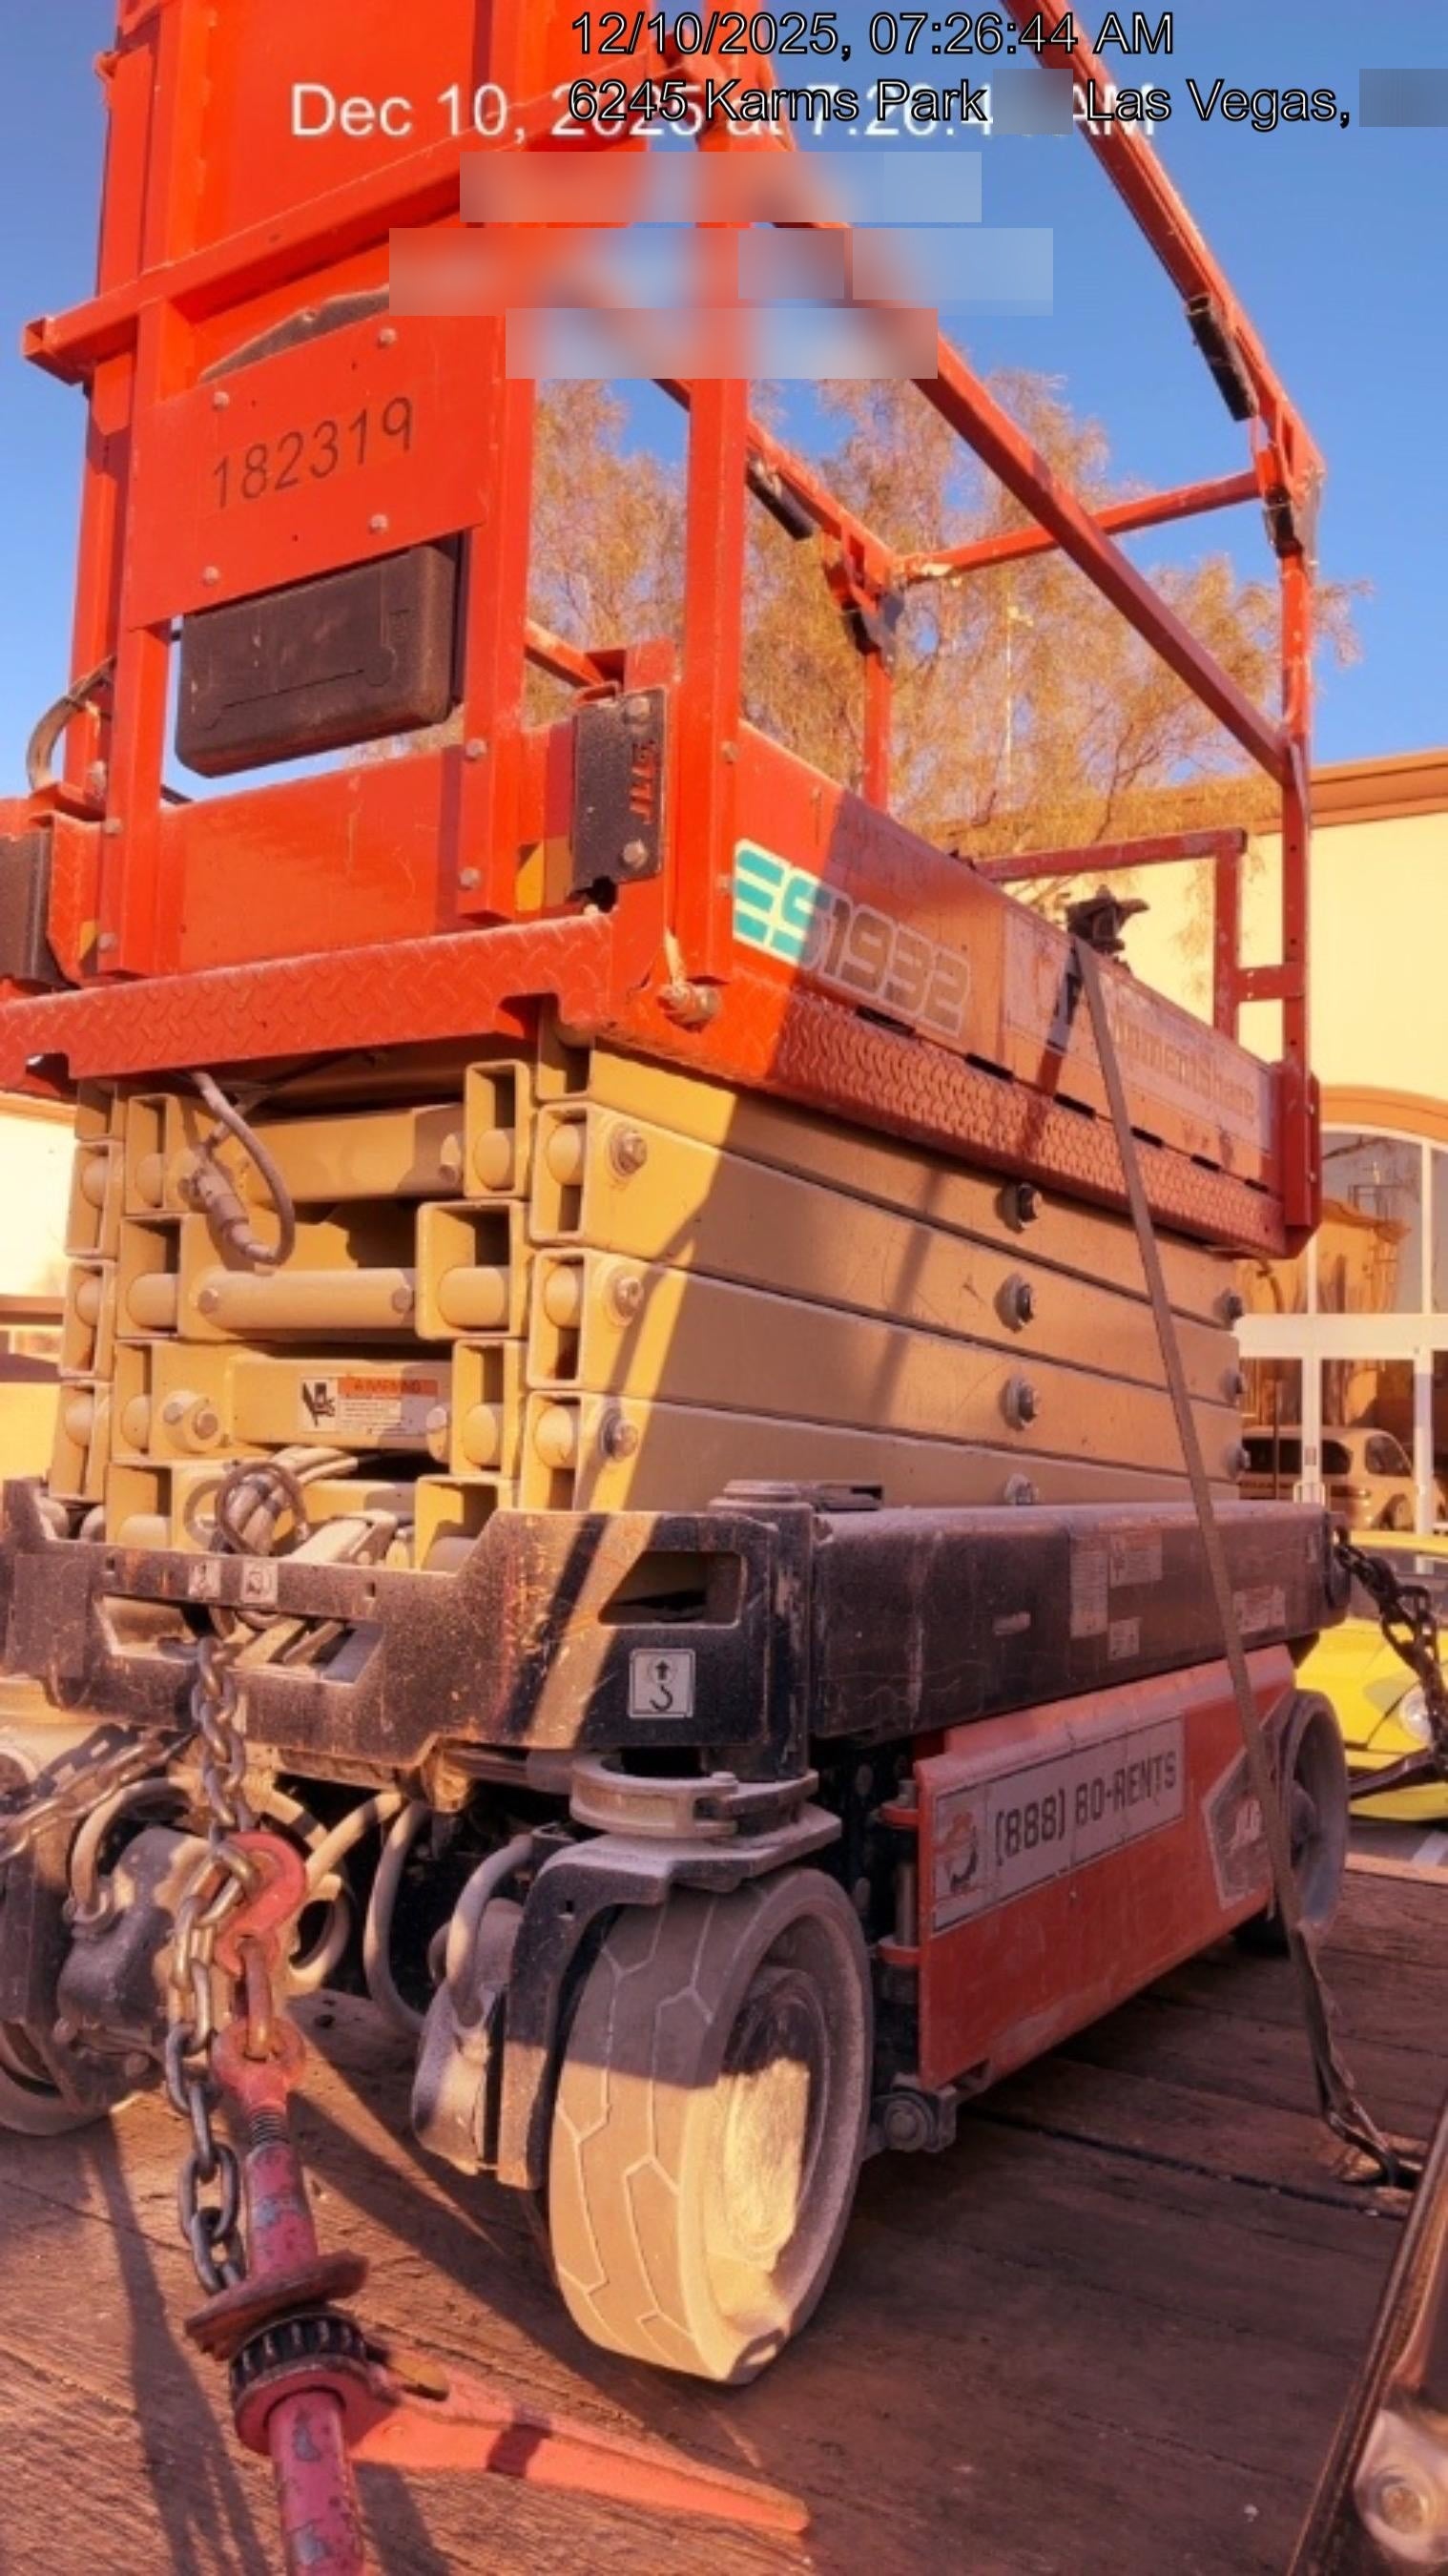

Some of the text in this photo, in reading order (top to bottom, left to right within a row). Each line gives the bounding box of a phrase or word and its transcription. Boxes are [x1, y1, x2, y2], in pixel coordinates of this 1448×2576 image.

[214, 397, 412, 508] 182319
[733, 838, 971, 1038] ES1932
[995, 1788, 1065, 1867] (888)
